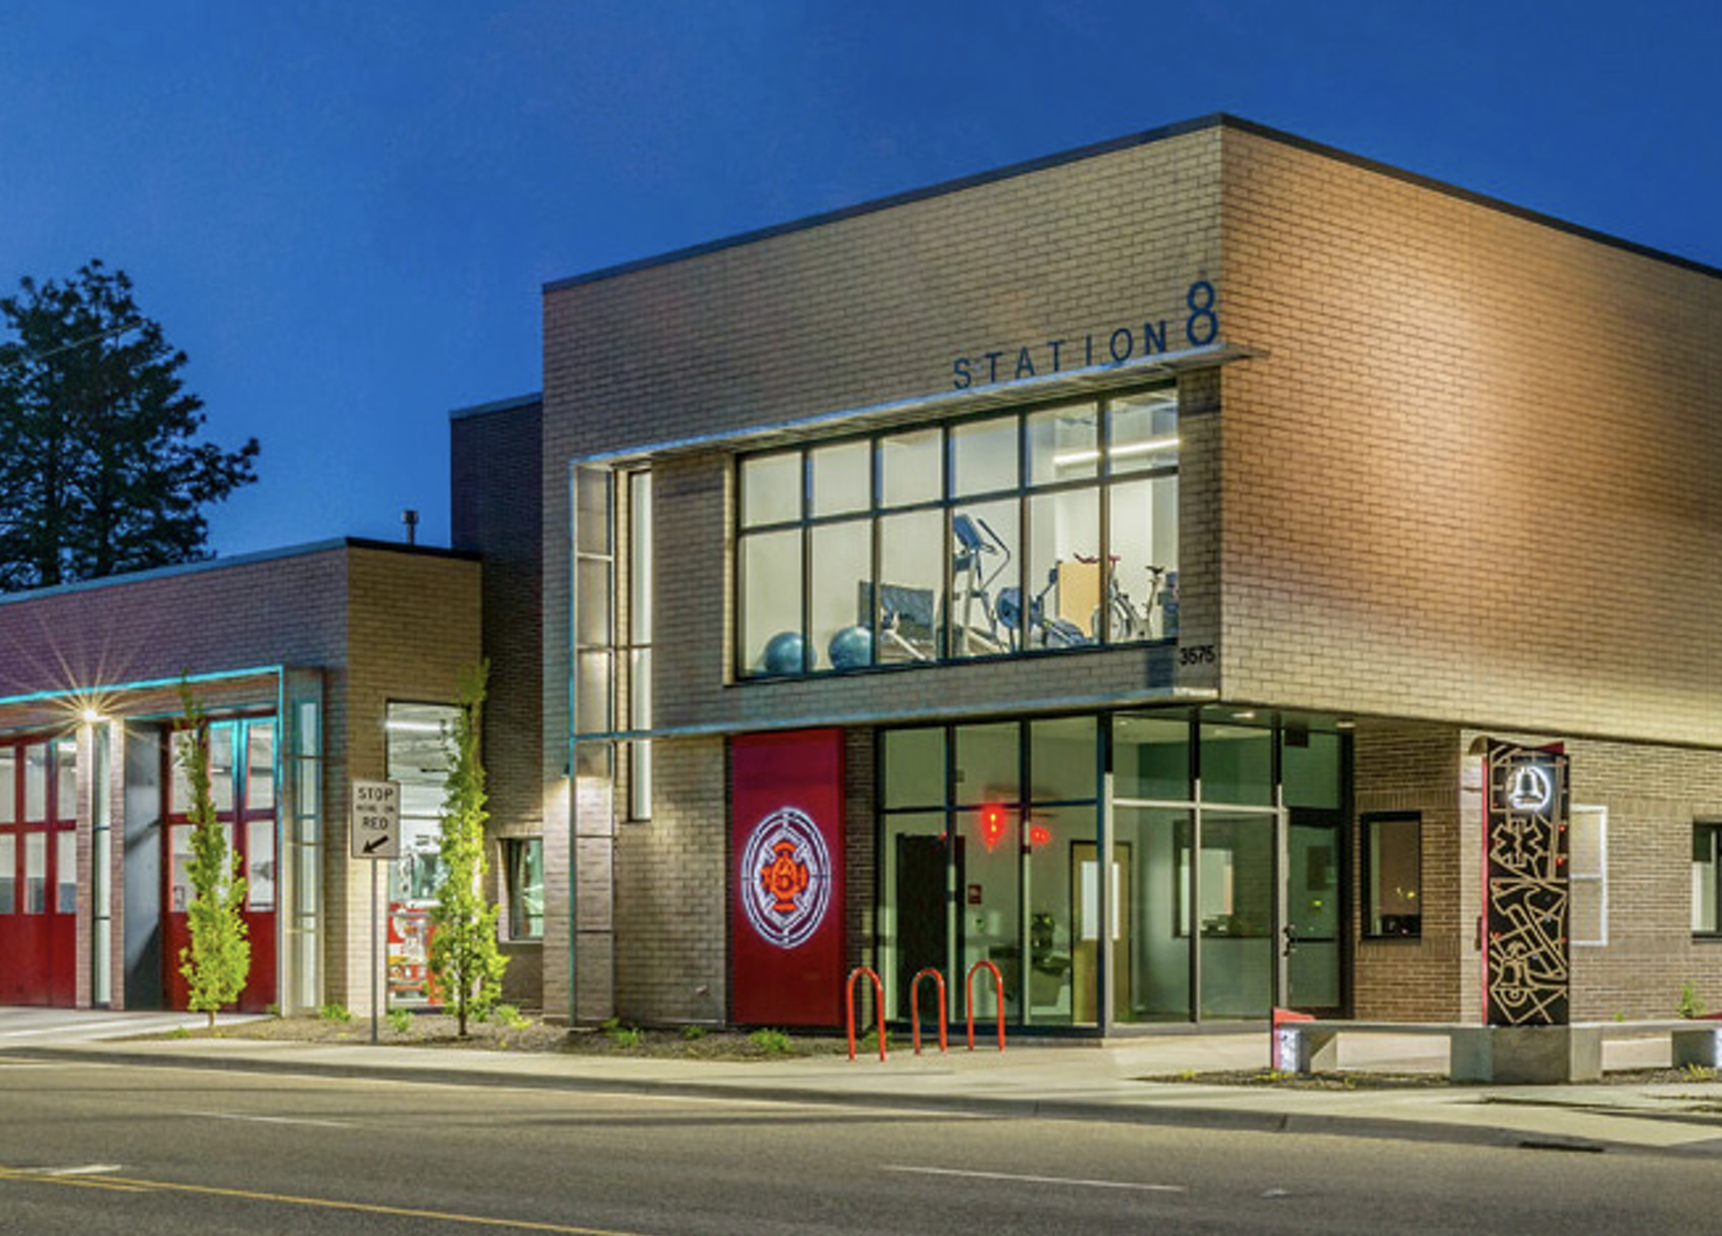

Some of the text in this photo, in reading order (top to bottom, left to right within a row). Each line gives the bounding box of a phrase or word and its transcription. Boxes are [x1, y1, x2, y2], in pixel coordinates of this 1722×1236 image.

[953, 279, 1219, 391] STATION 8
[1179, 644, 1216, 666] 3575
[358, 787, 393, 801] STOP
[362, 816, 389, 831] RED
